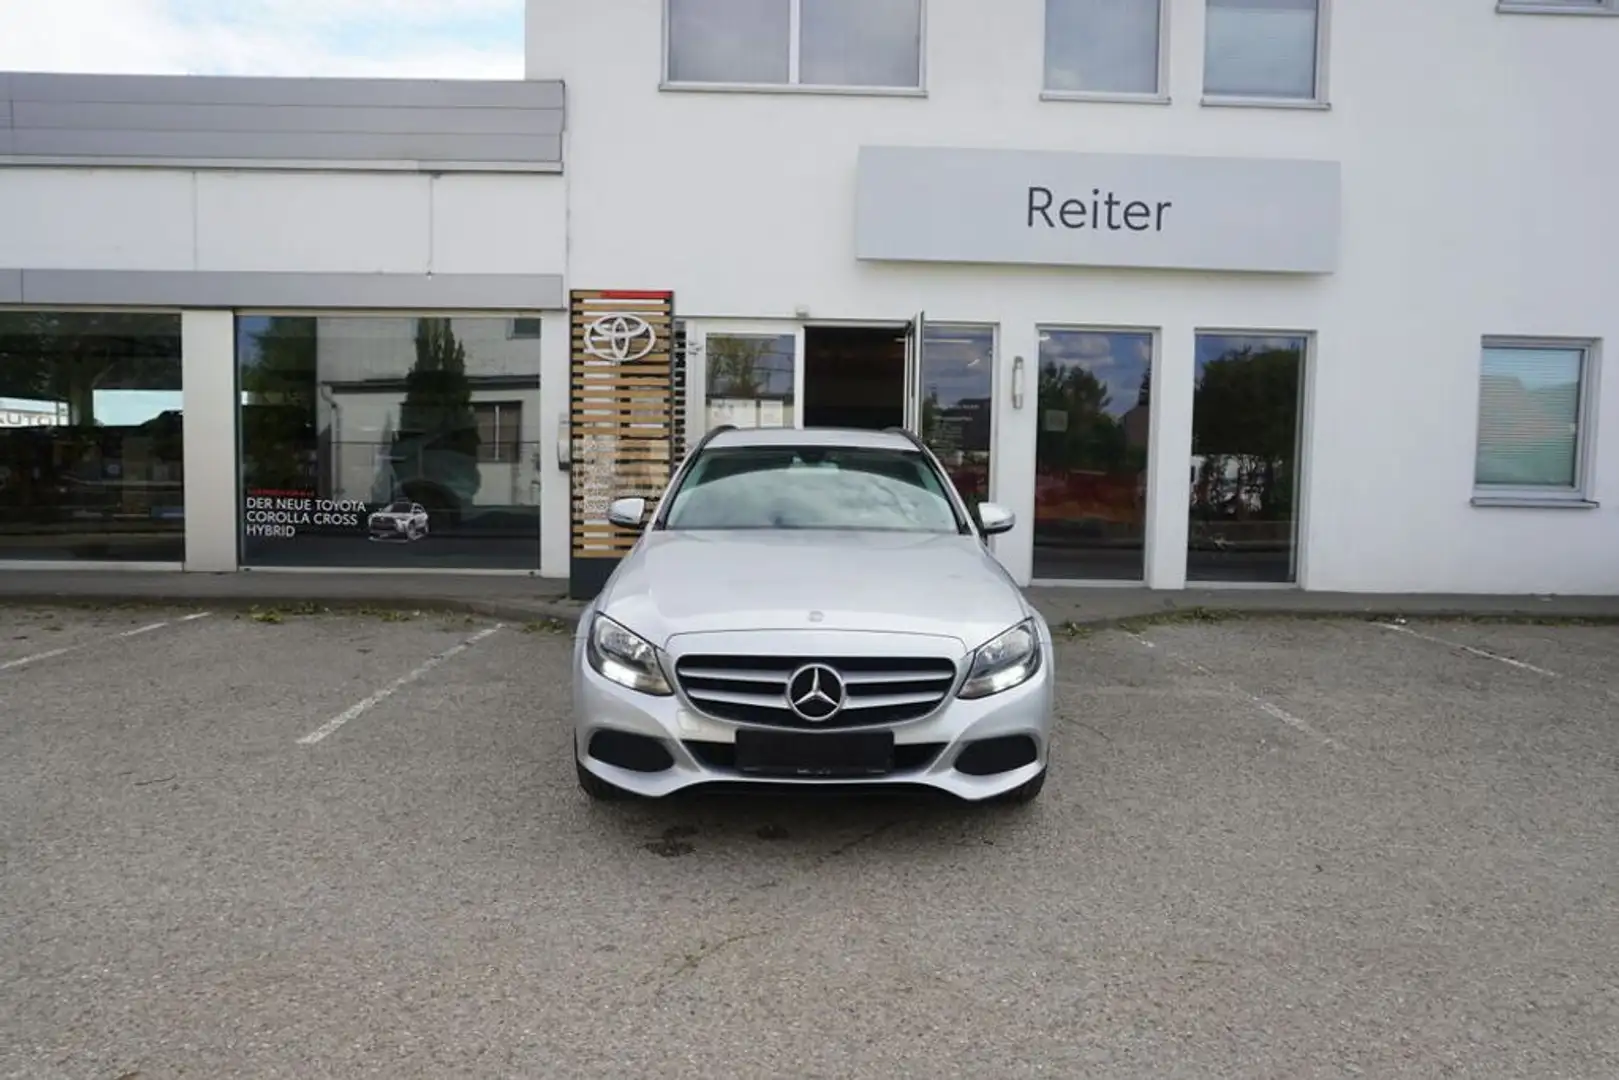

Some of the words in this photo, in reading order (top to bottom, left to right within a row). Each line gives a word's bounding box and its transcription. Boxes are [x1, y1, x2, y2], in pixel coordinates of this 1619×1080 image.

[1027, 186, 1172, 231] Reiter
[246, 497, 273, 509] DER
[276, 498, 312, 511] NEUE
[315, 500, 366, 512] TOYOTA
[246, 510, 310, 524] COROLLA
[313, 512, 358, 525] CROSS
[246, 523, 296, 537] HYBRID
